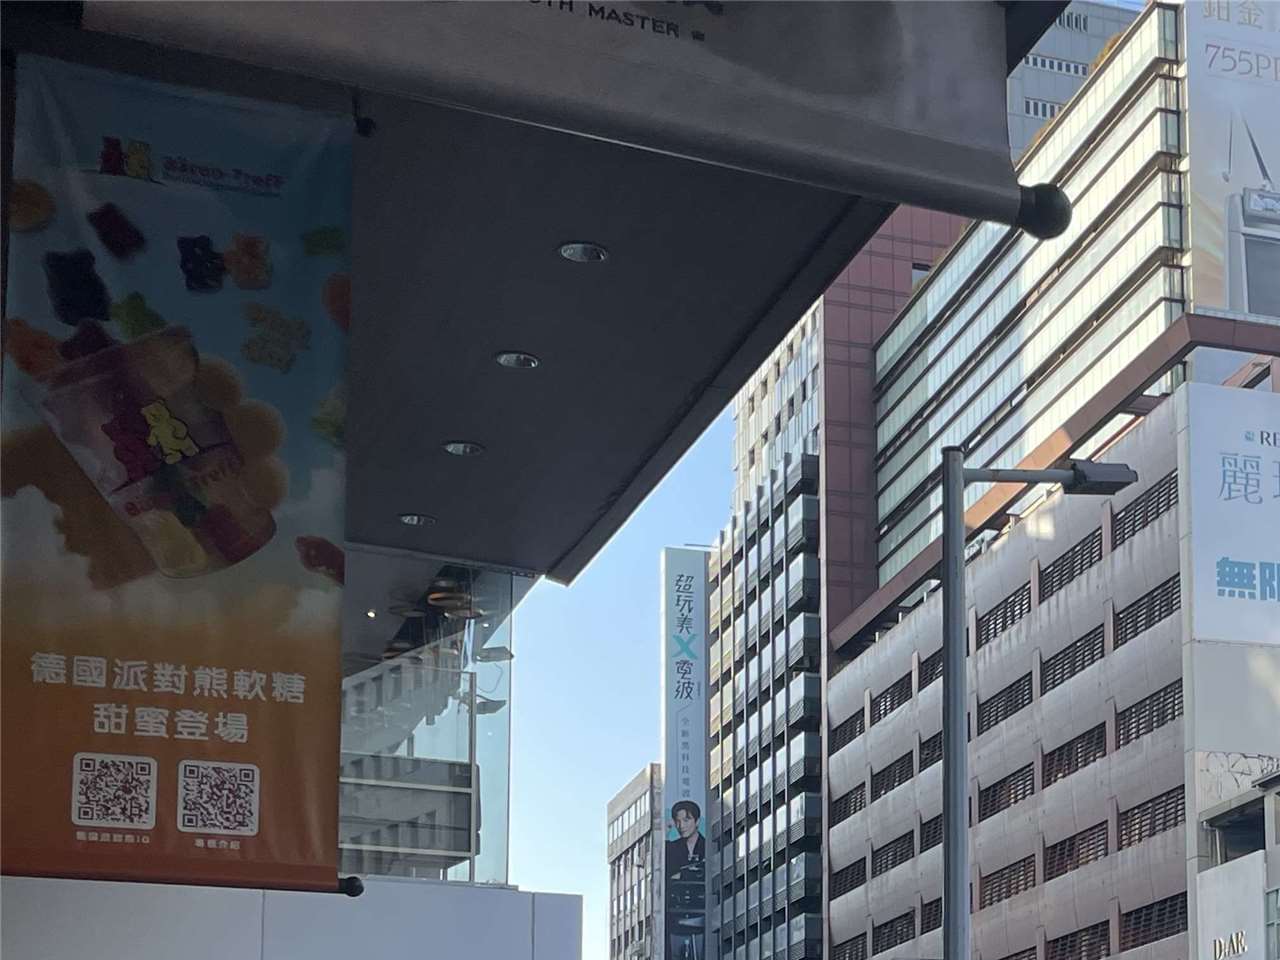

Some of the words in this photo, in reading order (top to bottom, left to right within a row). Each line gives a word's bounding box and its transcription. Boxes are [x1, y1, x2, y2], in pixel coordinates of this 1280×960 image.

[588, 3, 679, 38] MASTER
[30, 652, 306, 704] 德國派對熊軟糖
[93, 703, 249, 743] 甜蜜登場
